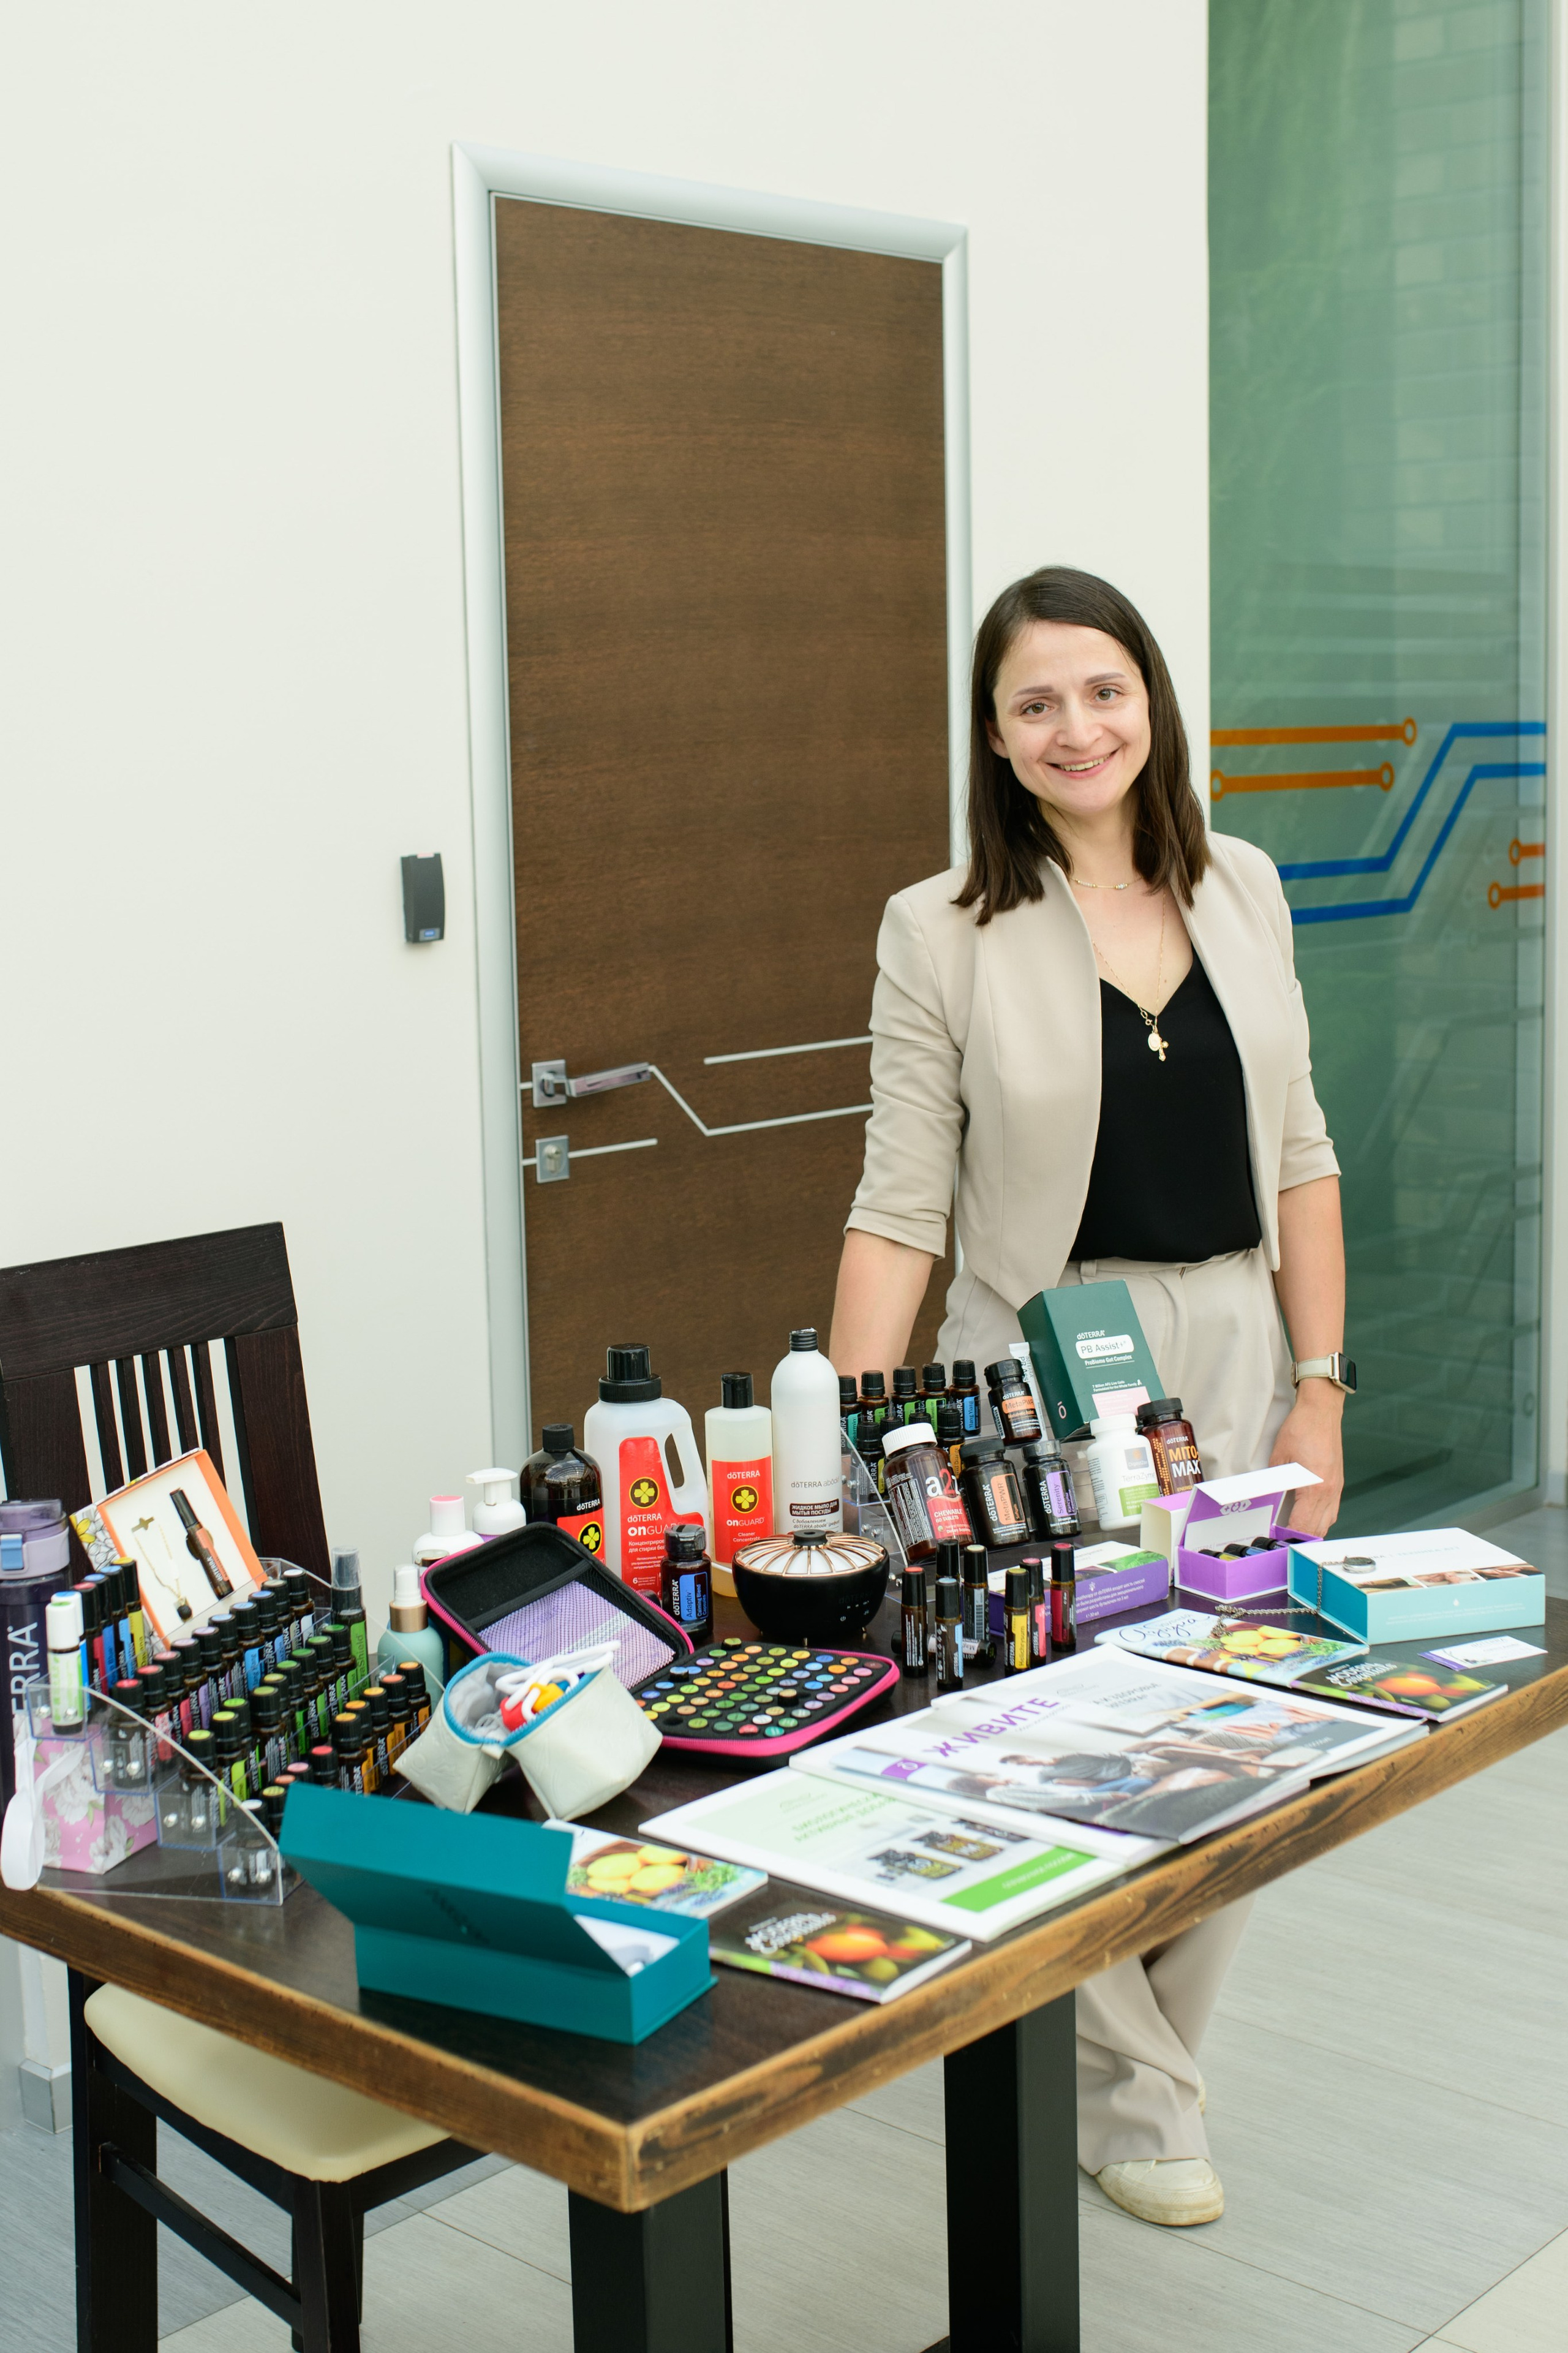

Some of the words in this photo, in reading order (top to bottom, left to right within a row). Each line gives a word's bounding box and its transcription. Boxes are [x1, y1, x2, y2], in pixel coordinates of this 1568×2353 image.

[1080, 1345, 1093, 1354] PB
[1171, 1460, 1202, 1478] MAX
[934, 1508, 963, 1518] CHEWABLE
[998, 1482, 1011, 1521] MetaPWR
[1054, 1484, 1064, 1514] Serenity
[7, 1622, 41, 1715] ERRA
[355, 1633, 368, 1686] erraShield
[922, 1698, 1060, 1758] ЖИВИТЕ
[353, 1765, 363, 1795] TERRA
